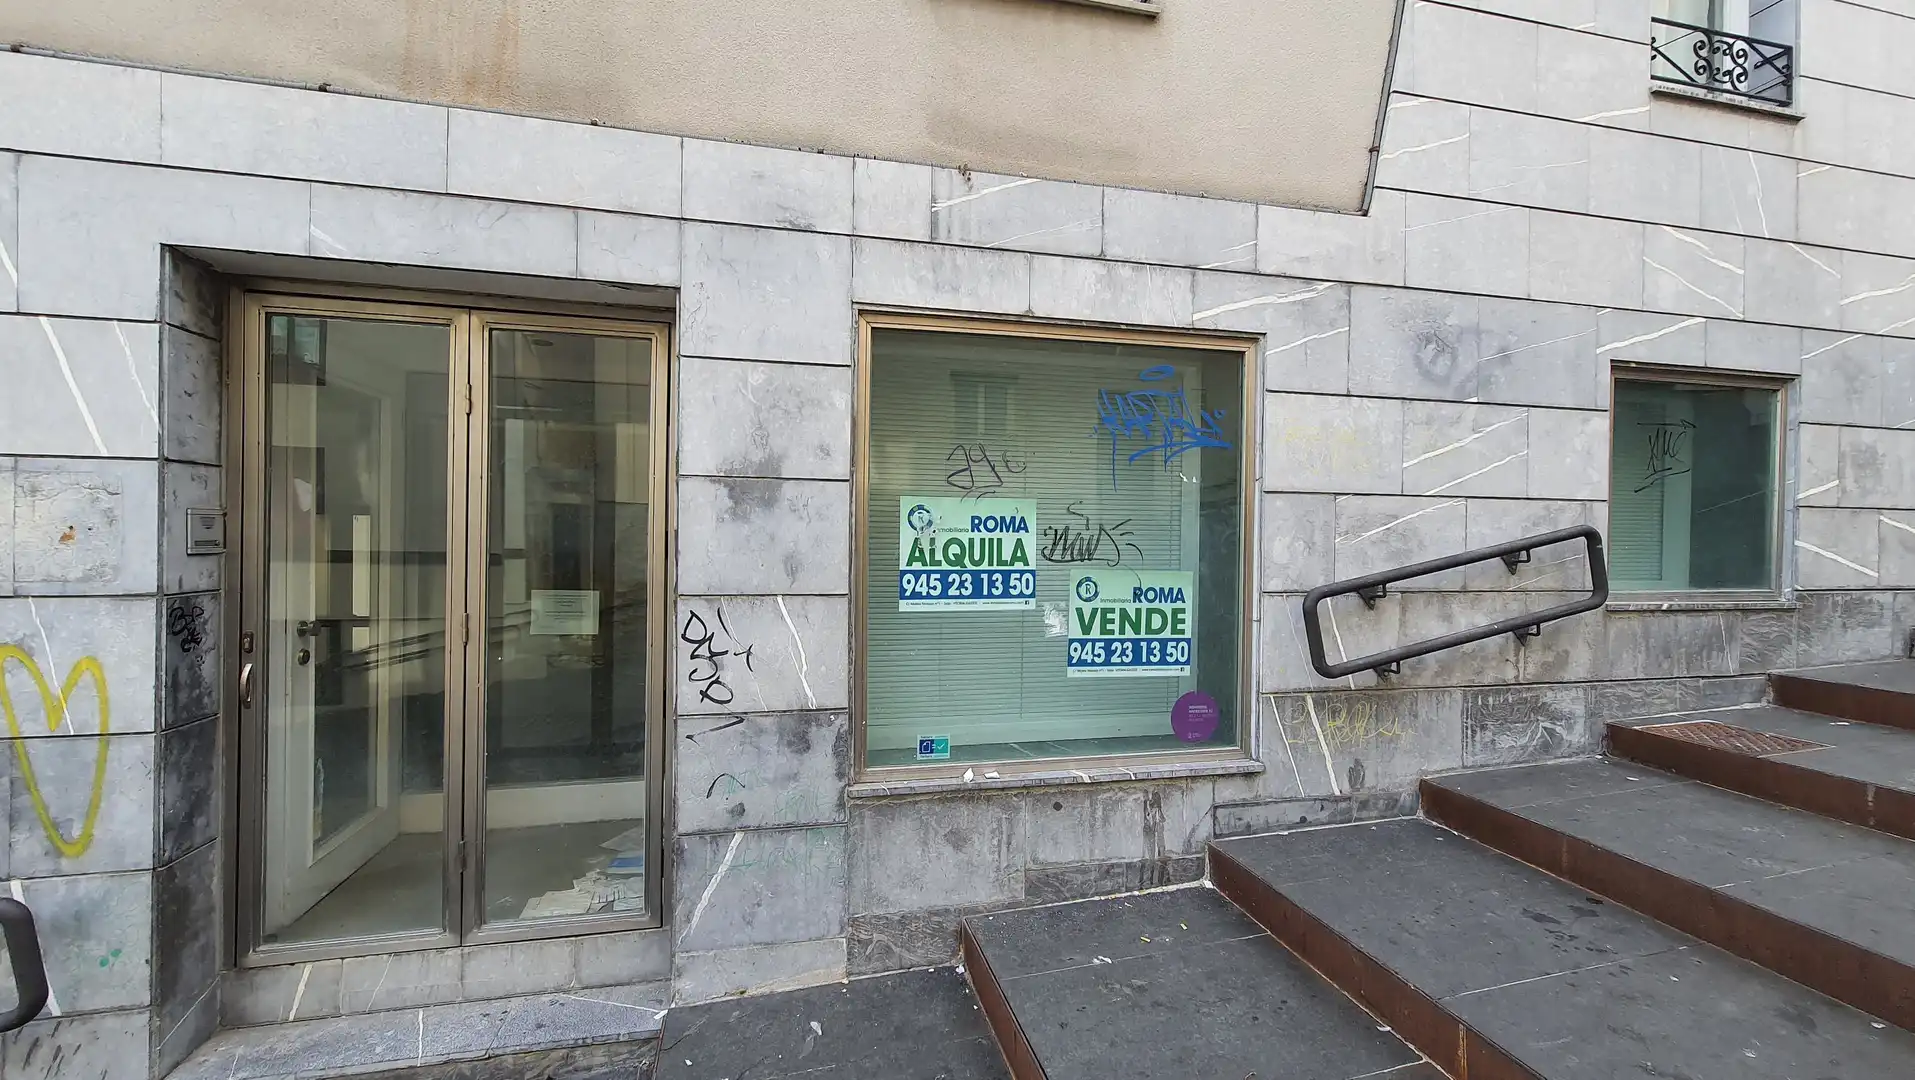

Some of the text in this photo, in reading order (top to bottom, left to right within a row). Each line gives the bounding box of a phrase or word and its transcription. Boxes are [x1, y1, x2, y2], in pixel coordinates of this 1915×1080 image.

[971, 515, 1030, 533] ROMA
[906, 537, 1030, 569] ALQUILA
[902, 572, 1034, 597] 945 23 13 50
[1132, 586, 1187, 604] ROMA
[1075, 607, 1187, 636] VENDE
[1069, 641, 1189, 664] 945 23 13 50
